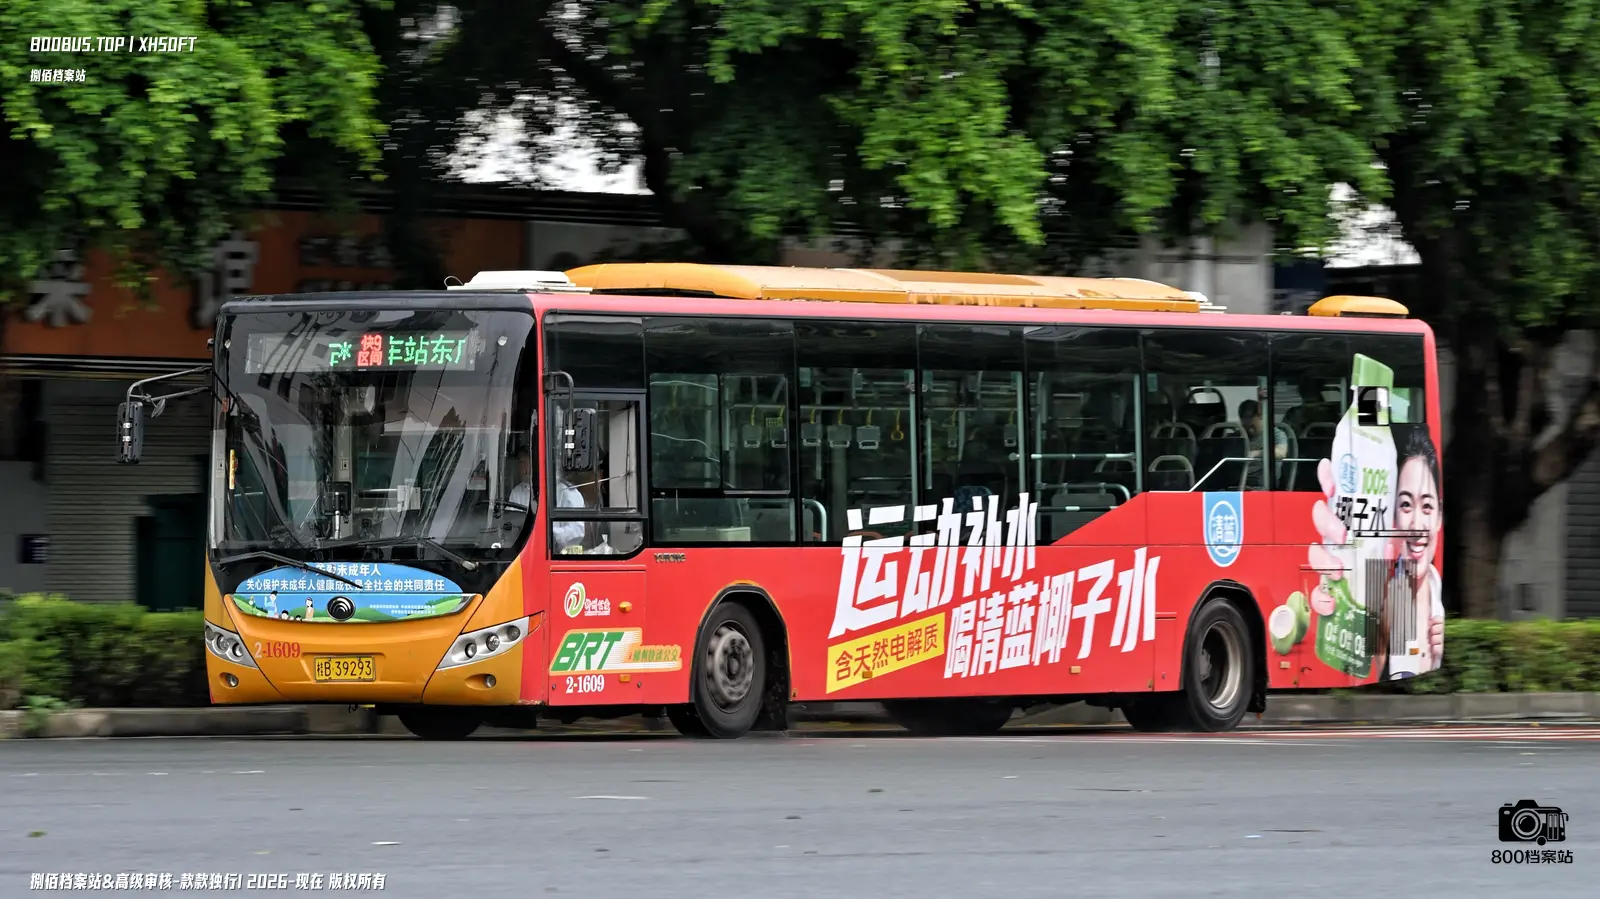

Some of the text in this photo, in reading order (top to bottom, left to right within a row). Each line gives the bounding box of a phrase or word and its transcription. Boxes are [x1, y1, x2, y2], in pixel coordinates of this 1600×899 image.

[357, 350, 383, 366] 区间
[1361, 466, 1388, 495] 100%
[828, 492, 1038, 639] 运动补水
[246, 579, 445, 591] 关心保护未成年人健康成长是全社会的共同责任
[943, 547, 1161, 679] 喝清蓝椰子水
[254, 641, 300, 658] 2-1609
[551, 631, 624, 671] BRT
[835, 623, 938, 681] 含天然电解质
[566, 674, 605, 693] 2-1609
